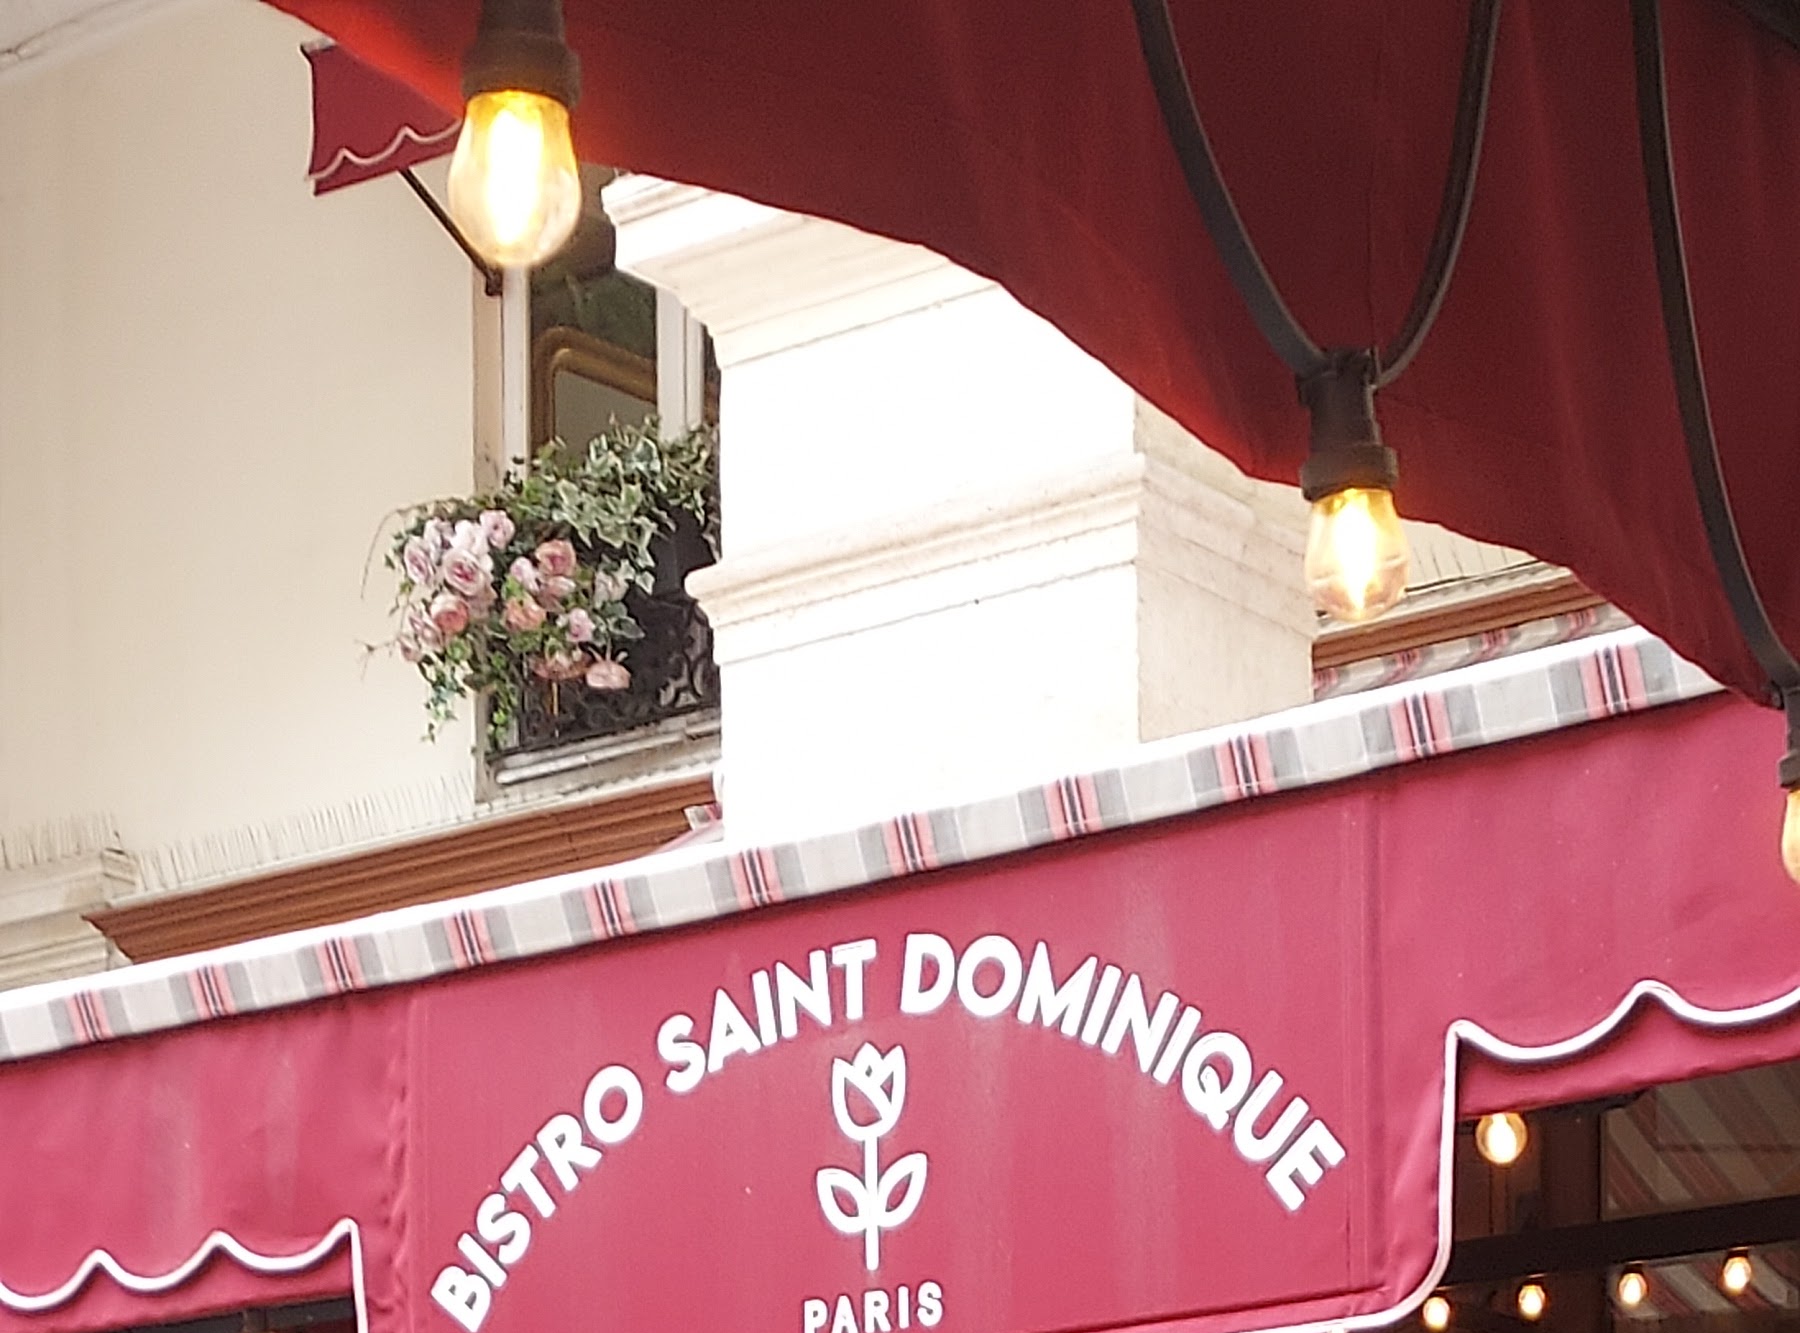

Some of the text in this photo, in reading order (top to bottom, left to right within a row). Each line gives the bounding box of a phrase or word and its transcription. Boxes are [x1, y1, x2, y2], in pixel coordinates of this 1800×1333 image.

[430, 933, 1346, 1333] BISTRO SAINT DOMINIQUE
